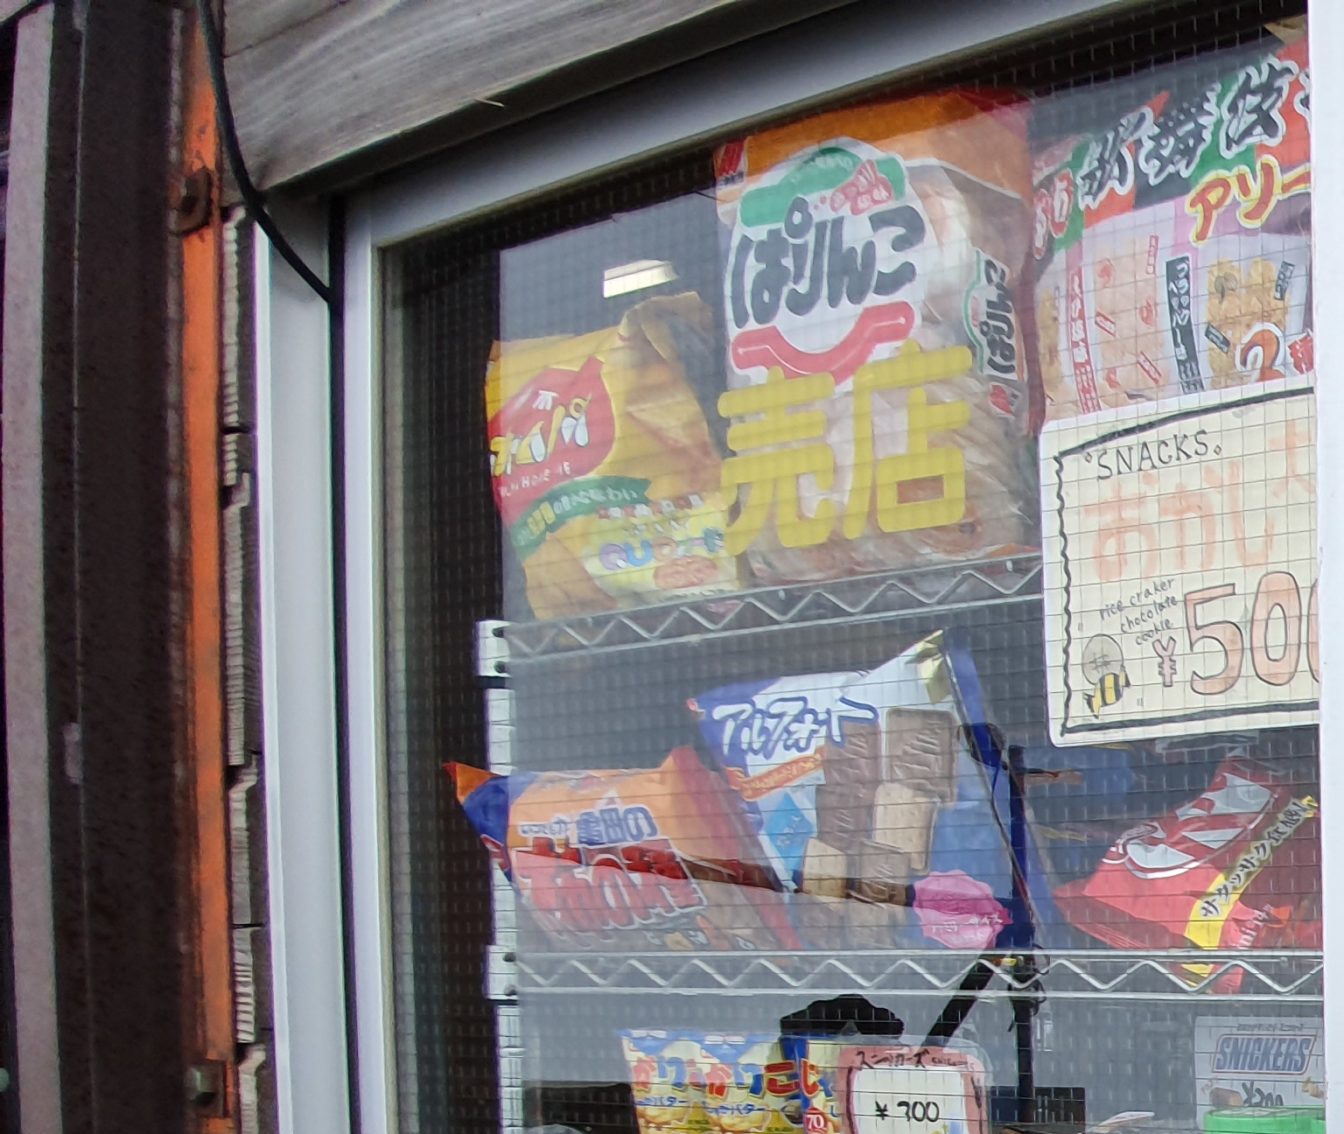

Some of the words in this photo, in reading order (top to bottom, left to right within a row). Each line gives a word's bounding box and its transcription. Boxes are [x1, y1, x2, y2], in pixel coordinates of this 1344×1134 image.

[729, 195, 926, 329] ぱりんこ
[978, 258, 1017, 375] ぱりんこ
[717, 338, 975, 556] 売店
[1096, 429, 1211, 481] SNACKS
[1083, 461, 1277, 582] おかし
[1099, 599, 1126, 621] rice
[1119, 594, 1179, 634] chocolate
[1135, 619, 1175, 646] cookie
[711, 695, 879, 761] アルフォート
[1215, 1036, 1313, 1073] SNICKERS
